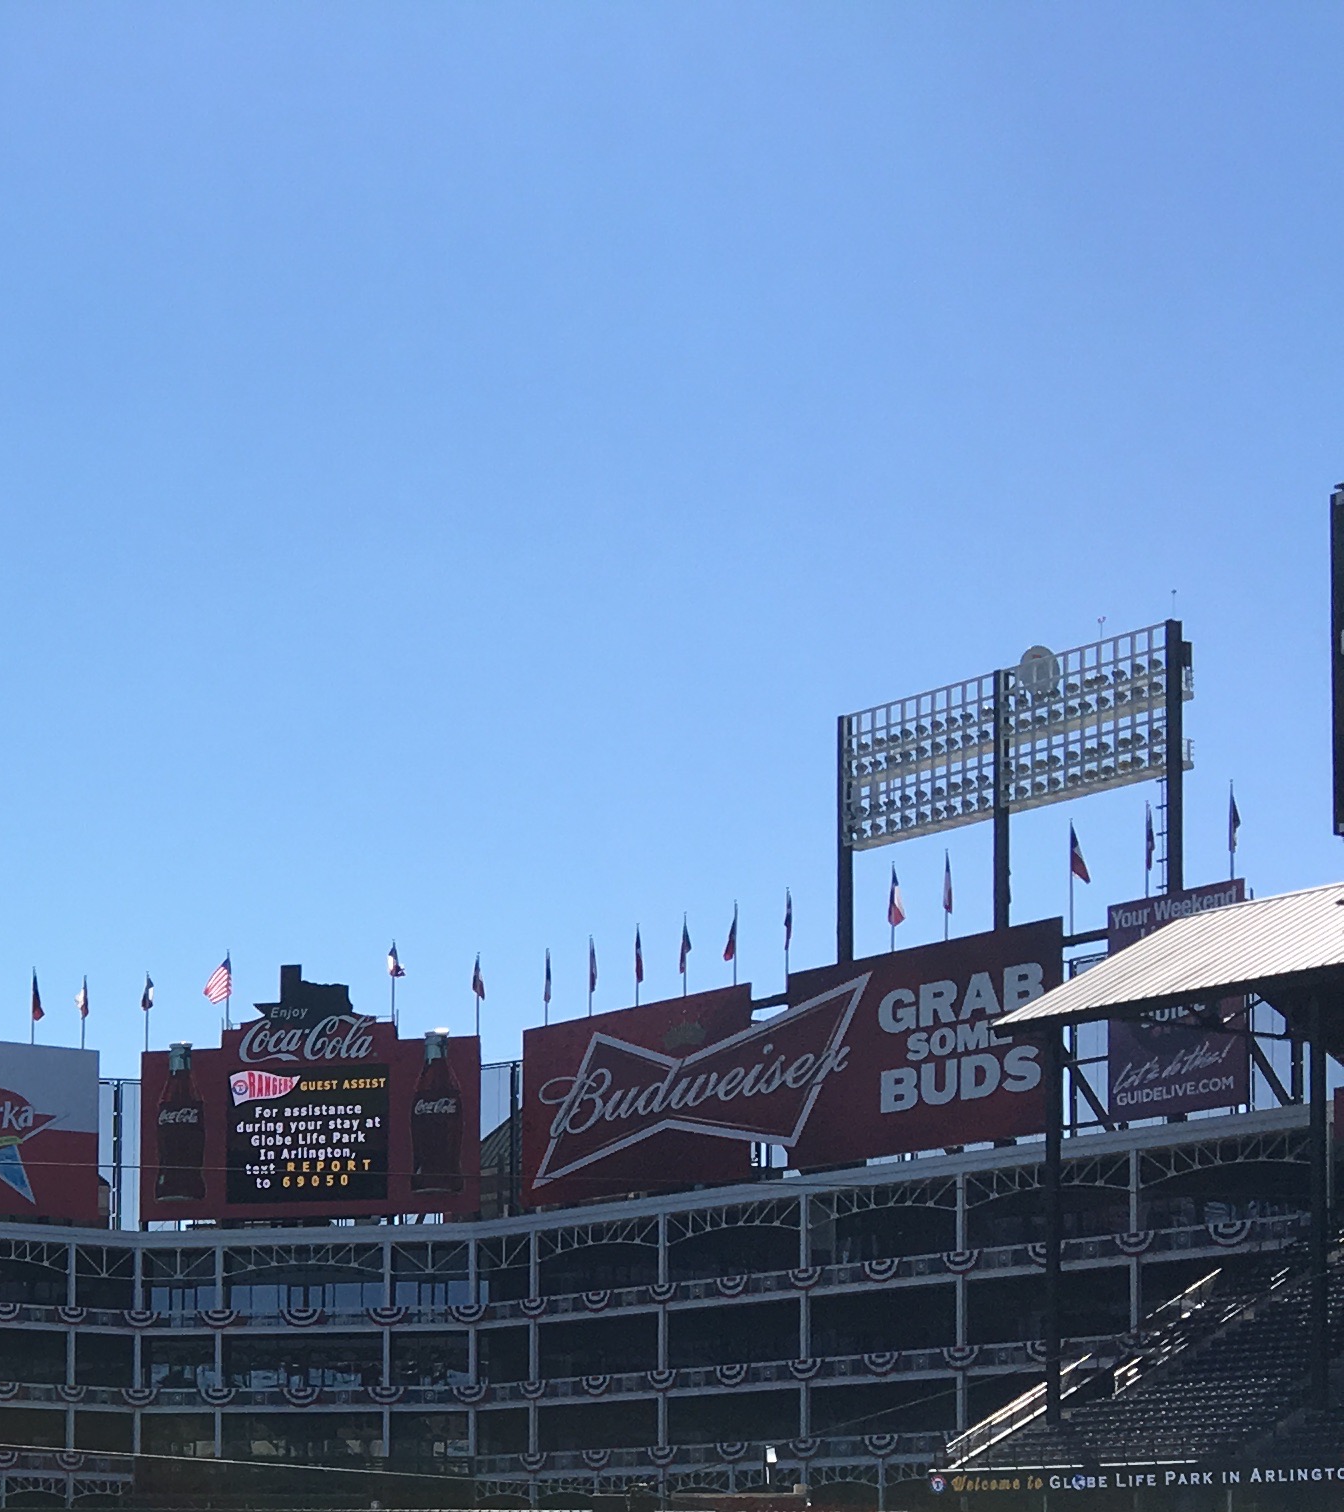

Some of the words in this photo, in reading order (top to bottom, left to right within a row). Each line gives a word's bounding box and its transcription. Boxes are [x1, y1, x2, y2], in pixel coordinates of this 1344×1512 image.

[1112, 905, 1151, 930] Your
[1154, 885, 1237, 920] Weekend
[878, 962, 1046, 1034] GRAB
[270, 1005, 309, 1021] Enjoy
[238, 1015, 378, 1063] Coca-Cola
[248, 1071, 296, 1099] RANGERS
[300, 1079, 338, 1091] GUEST
[342, 1077, 386, 1090] ASSIST
[880, 1045, 1042, 1113] BUDS
[1113, 1056, 1159, 1094] Let's
[538, 1043, 849, 1138] Budweiser
[1117, 1074, 1234, 1106] GUIDELIVE.COM
[158, 1108, 199, 1123] Coca-Cola
[255, 1106, 278, 1118] For
[284, 1103, 362, 1117] assistance
[414, 1098, 457, 1114] Coca-Cola
[236, 1121, 284, 1134] during
[289, 1120, 323, 1133] your
[328, 1117, 361, 1131] stay
[365, 1116, 381, 1128] at
[251, 1133, 292, 1147] Globe
[298, 1132, 326, 1145] Life
[332, 1131, 366, 1144] Park
[280, 1147, 356, 1161] Arlington,
[286, 1159, 371, 1172] REPORT
[256, 1177, 270, 1189] to
[282, 1174, 349, 1188] 69050
[951, 1475, 1020, 1493] Welcome
[1028, 1475, 1044, 1492] to
[1116, 1472, 1157, 1489] LIFE
[1165, 1470, 1213, 1487] PARK
[1222, 1470, 1240, 1485] IN
